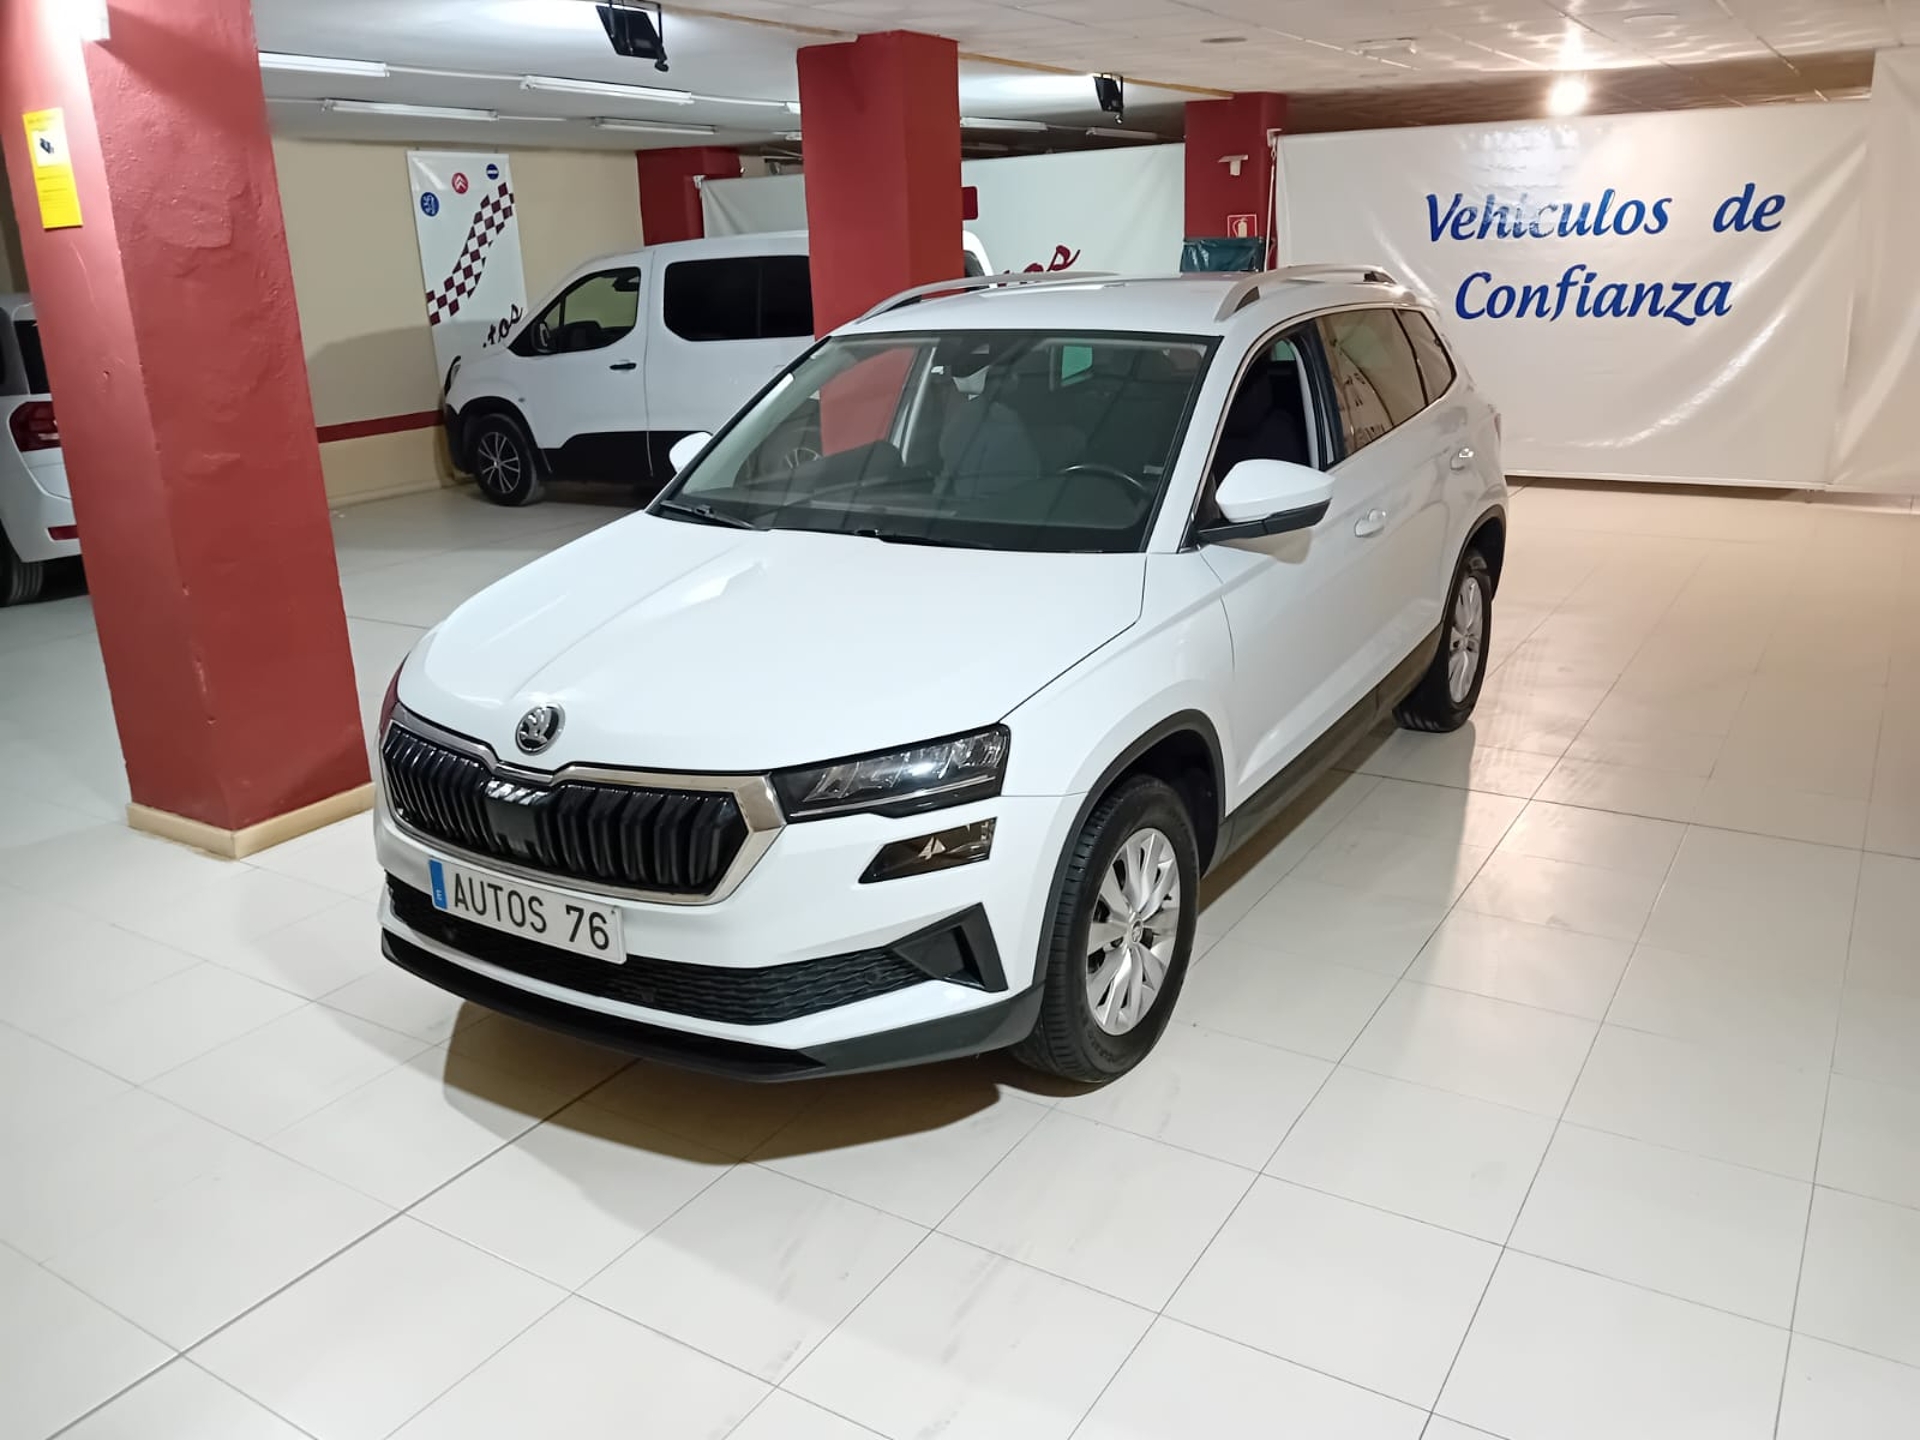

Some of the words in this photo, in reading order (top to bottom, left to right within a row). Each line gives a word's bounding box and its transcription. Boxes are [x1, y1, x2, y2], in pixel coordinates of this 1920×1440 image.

[1712, 183, 1786, 233] de
[1455, 264, 1733, 326] Confianza
[482, 303, 523, 348] tos
[454, 873, 547, 933] AUTOS
[565, 904, 610, 951] 76
